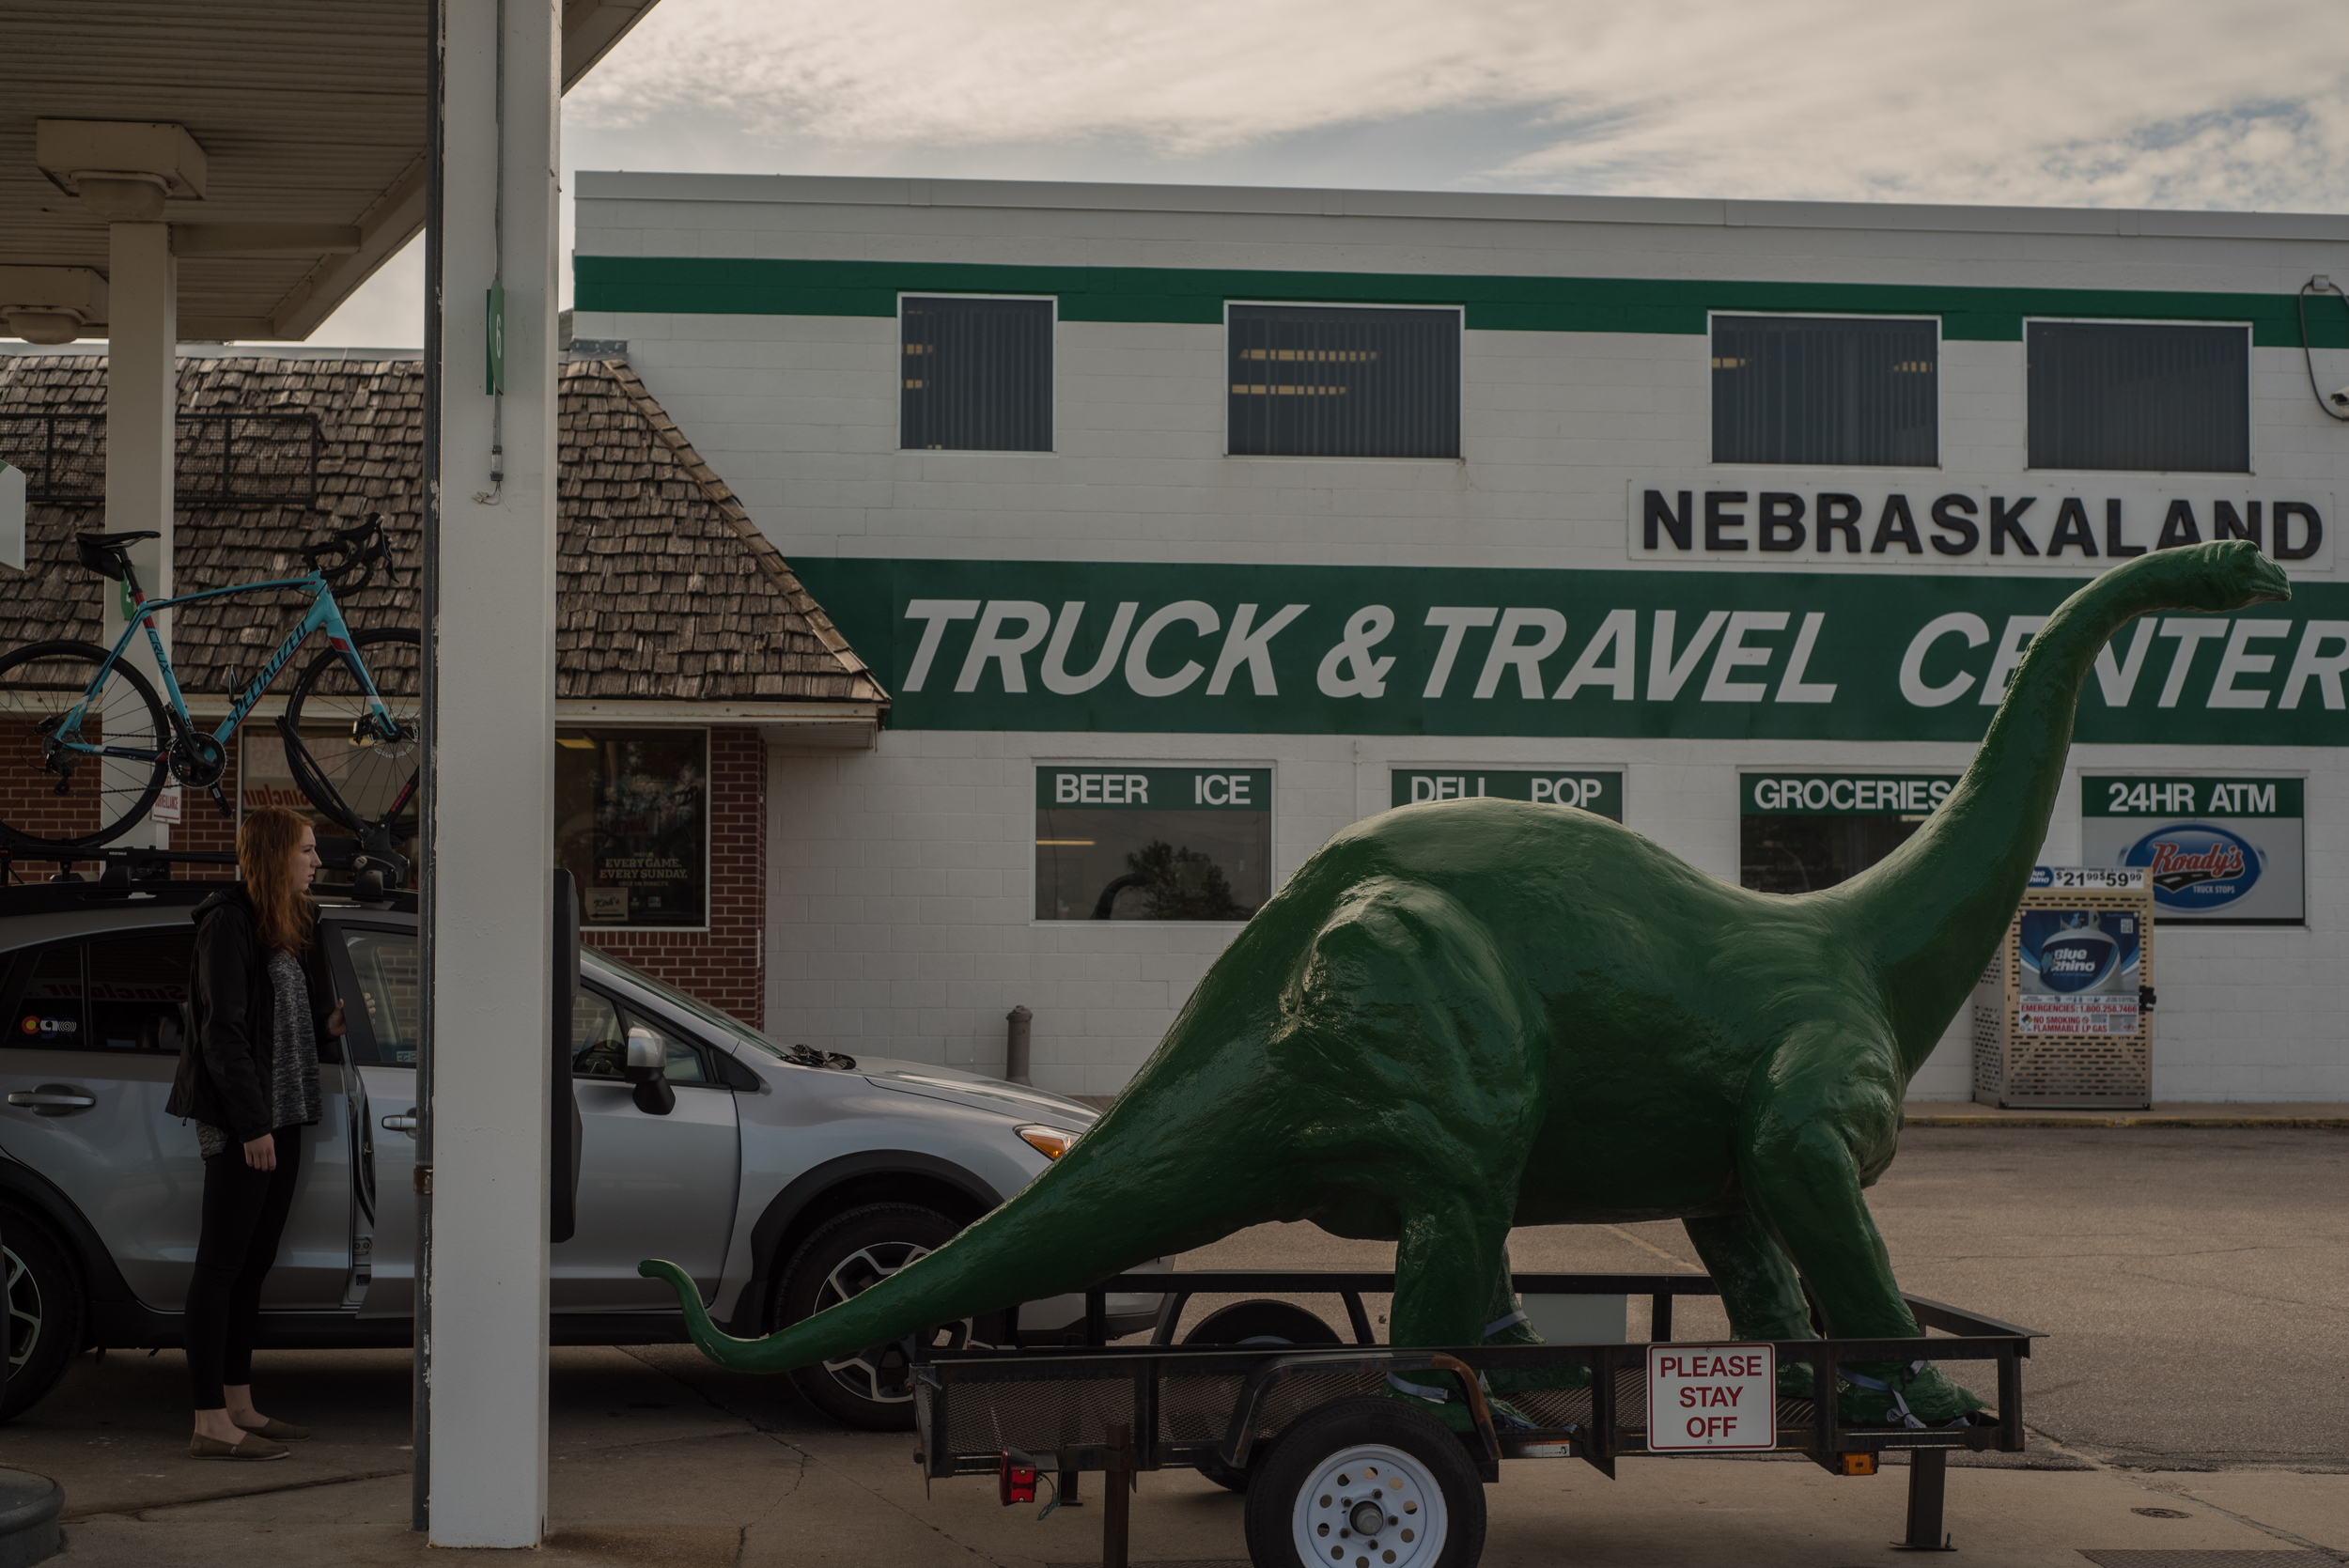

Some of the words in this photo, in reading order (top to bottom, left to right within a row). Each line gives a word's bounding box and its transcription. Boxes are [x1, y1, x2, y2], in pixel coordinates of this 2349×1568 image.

[496, 313, 502, 359] 6
[1643, 489, 2323, 560] NEBRASKALAND
[148, 630, 172, 675] CRUX
[901, 598, 1311, 697] TRUCK
[1316, 604, 1397, 699] &
[1422, 606, 1838, 704] TRAVEL
[1898, 611, 2349, 710] CENTER
[227, 620, 307, 731] SPECIALIZED
[1056, 773, 1148, 803] BEER
[1194, 774, 1252, 805] ICE
[1532, 777, 1602, 808] POP
[1754, 778, 1952, 811] GROCERIES
[2108, 782, 2195, 812] 24HR
[2208, 783, 2277, 813] ATM
[599, 869, 640, 878] EVERY
[640, 869, 688, 878] SUNDAY.
[605, 859, 645, 868] EVERY
[645, 859, 682, 868] GAME.
[2153, 842, 2244, 877] Roady's
[2192, 885, 2214, 893] TRUCK
[2215, 886, 2235, 894] STOPS
[2054, 948, 2088, 960] Blue
[2021, 1004, 2078, 1013] EMERGENCIES:
[1660, 1356, 1763, 1377] PLEASE
[1679, 1386, 1744, 1408] STAY
[1687, 1417, 1737, 1438] OFF
[1369, 1421, 1458, 1478] CARLISLE
